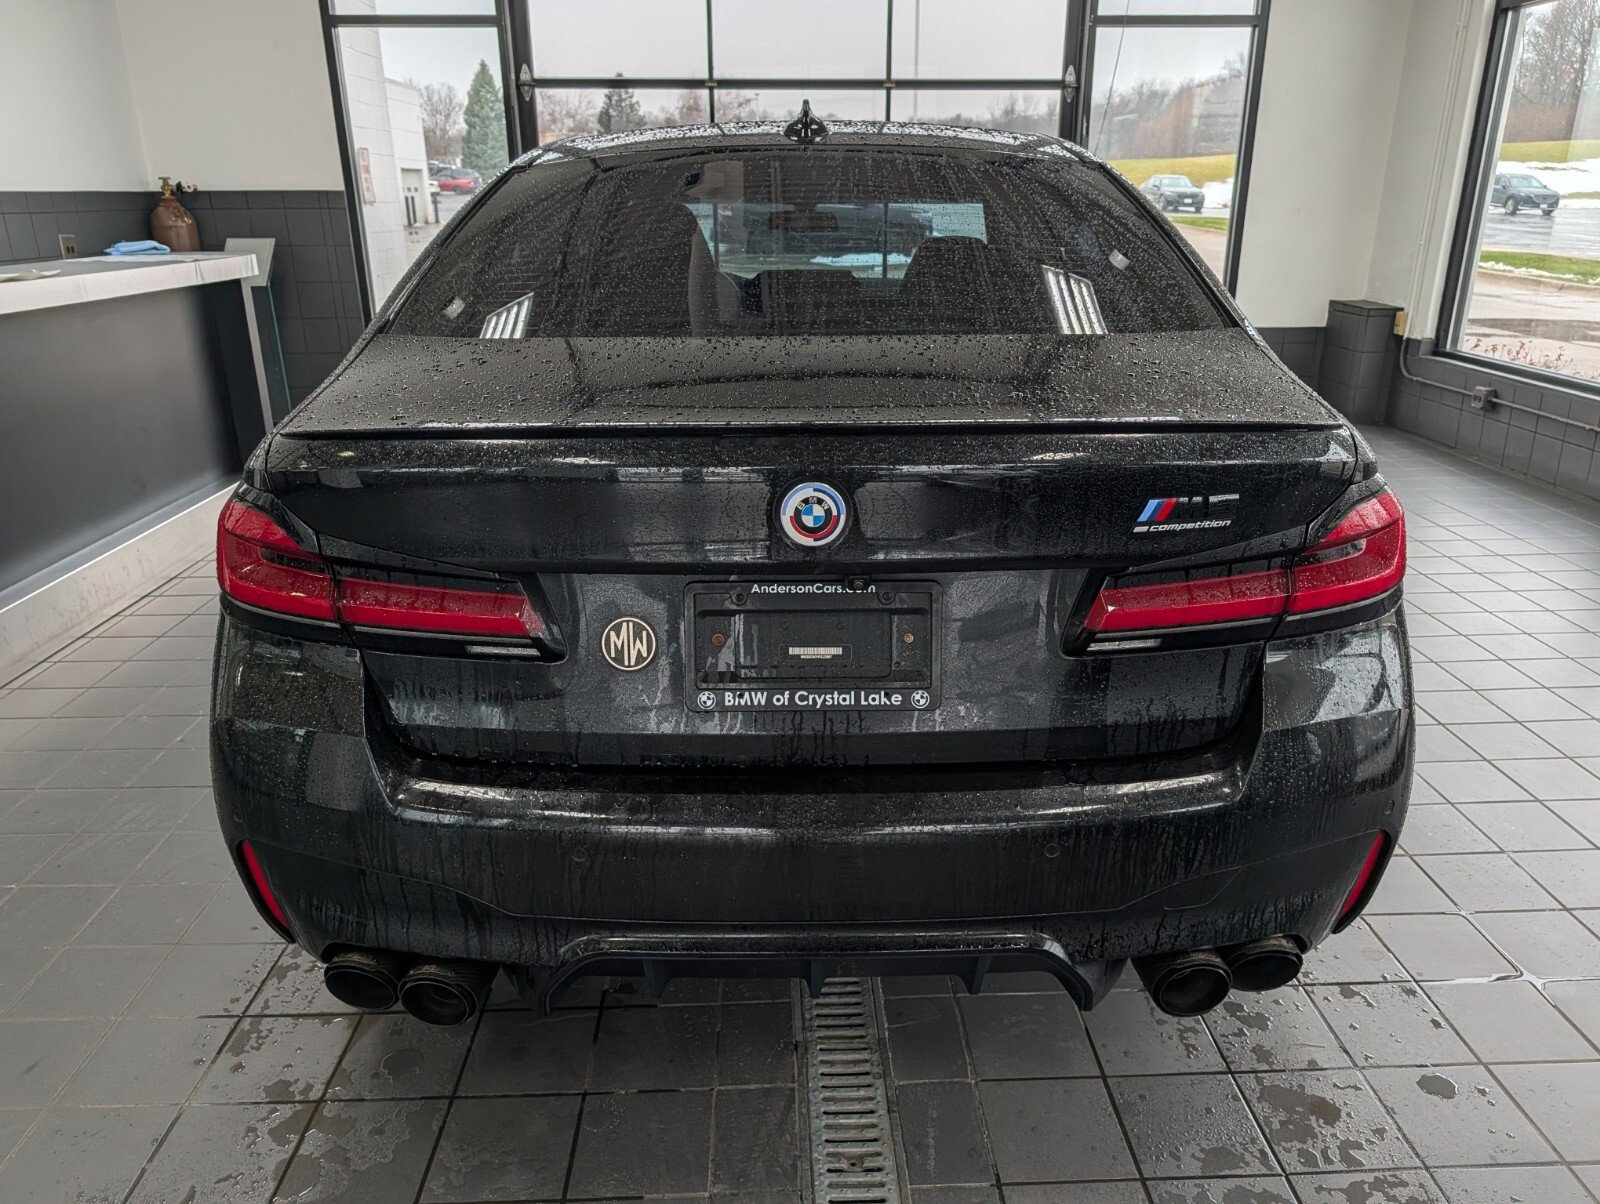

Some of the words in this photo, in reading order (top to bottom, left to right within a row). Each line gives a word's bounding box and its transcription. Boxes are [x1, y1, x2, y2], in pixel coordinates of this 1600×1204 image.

[796, 495, 830, 510] BMW
[1149, 520, 1231, 532] competition
[751, 583, 876, 594] AndersonCars.m
[724, 691, 768, 706] BMW
[772, 690, 790, 706] of
[794, 690, 855, 709] Crystal
[860, 690, 903, 705] Lake
